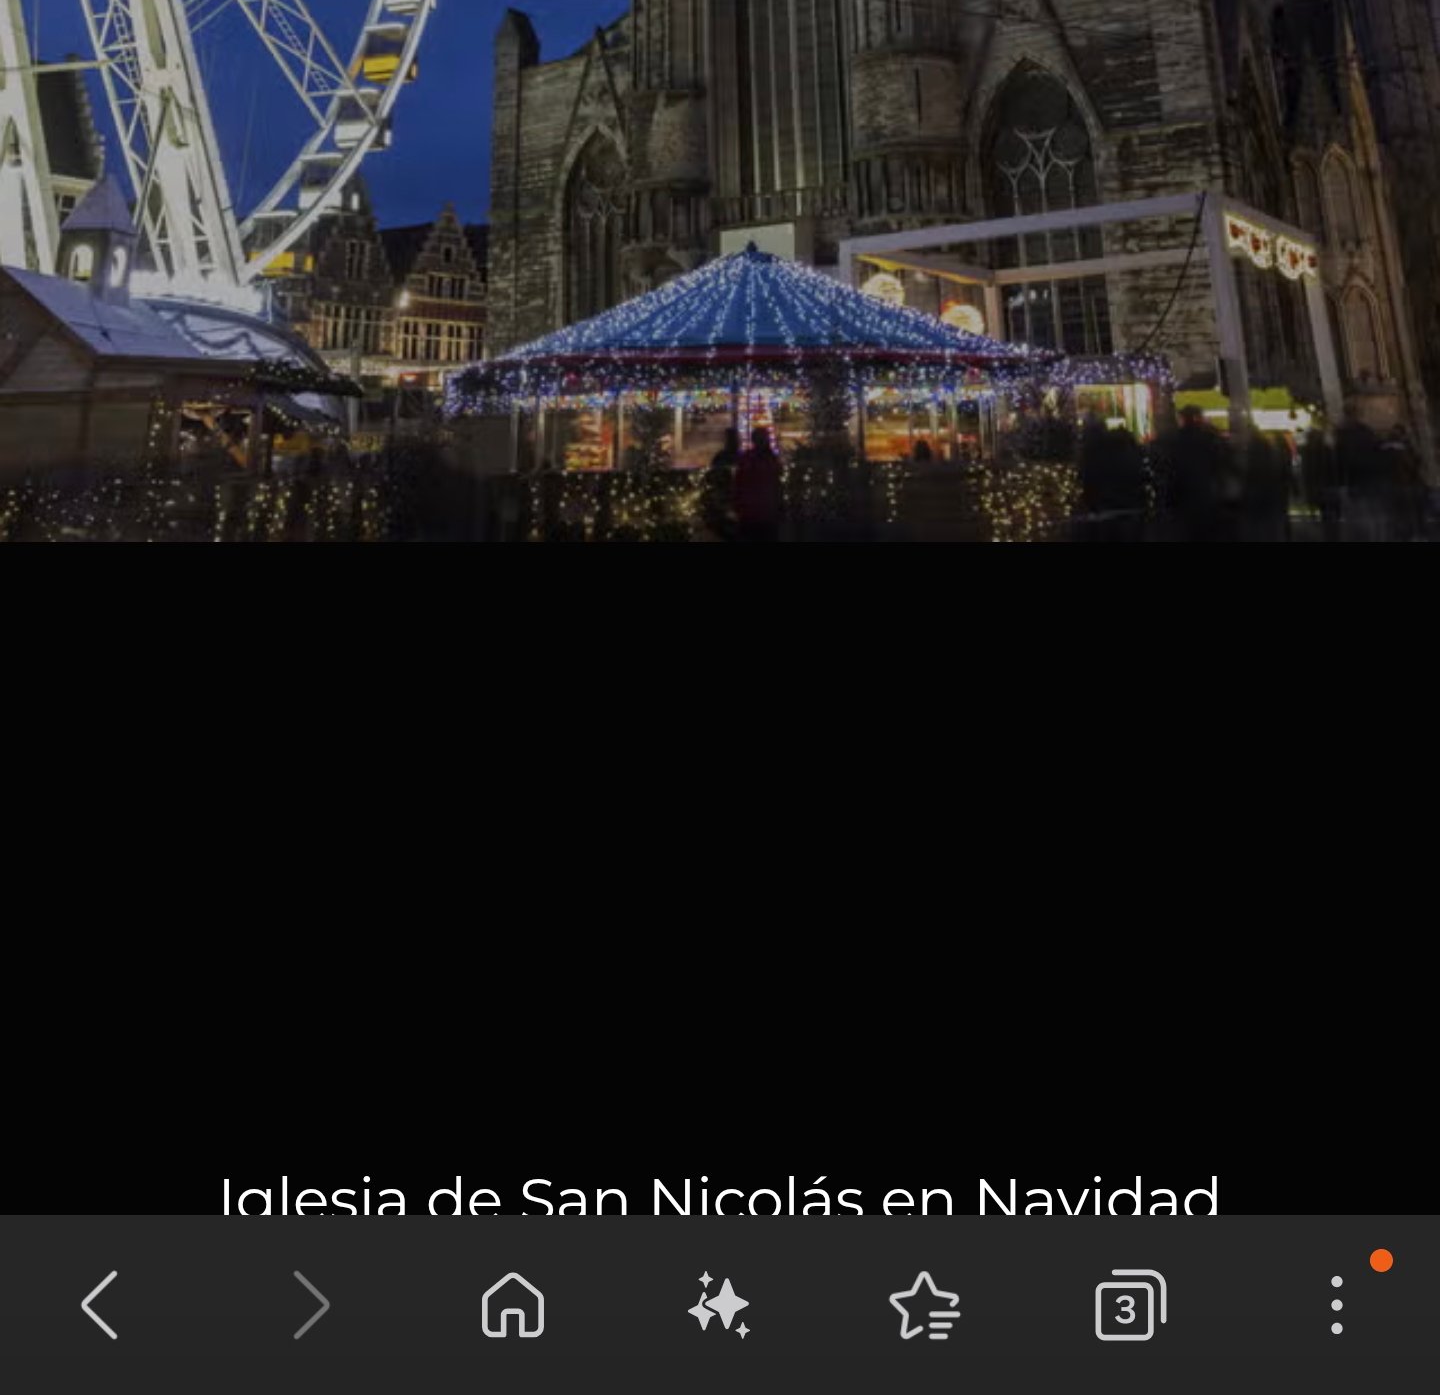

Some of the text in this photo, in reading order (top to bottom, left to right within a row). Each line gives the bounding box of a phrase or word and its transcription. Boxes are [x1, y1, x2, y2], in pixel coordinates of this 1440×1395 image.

[223, 1175, 1218, 1216] Iglesia de San Nicolás en Navidad
[1114, 1294, 1136, 1324] 3
